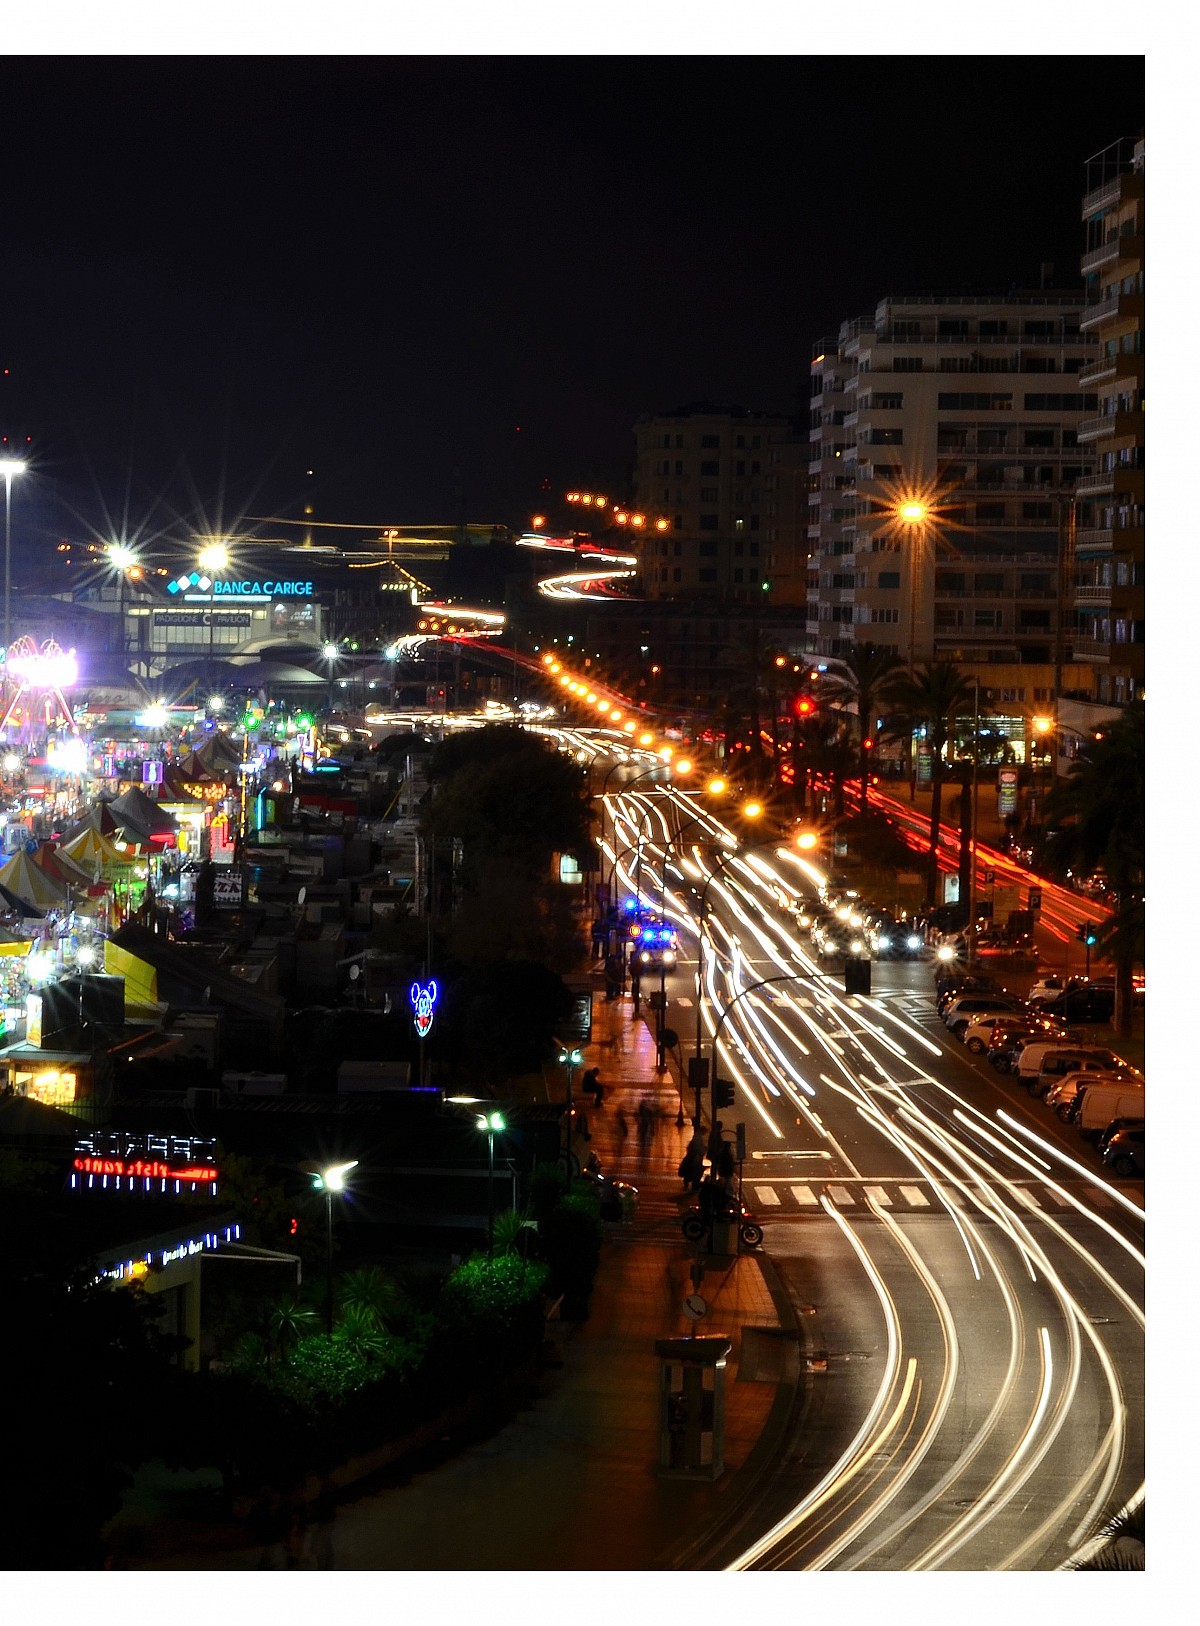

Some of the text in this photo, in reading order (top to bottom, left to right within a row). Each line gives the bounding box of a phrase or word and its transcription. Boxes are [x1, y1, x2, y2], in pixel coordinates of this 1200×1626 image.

[214, 581, 313, 595] BANCA CARIGE
[156, 613, 249, 625] PADIGLIONE C PAVILION
